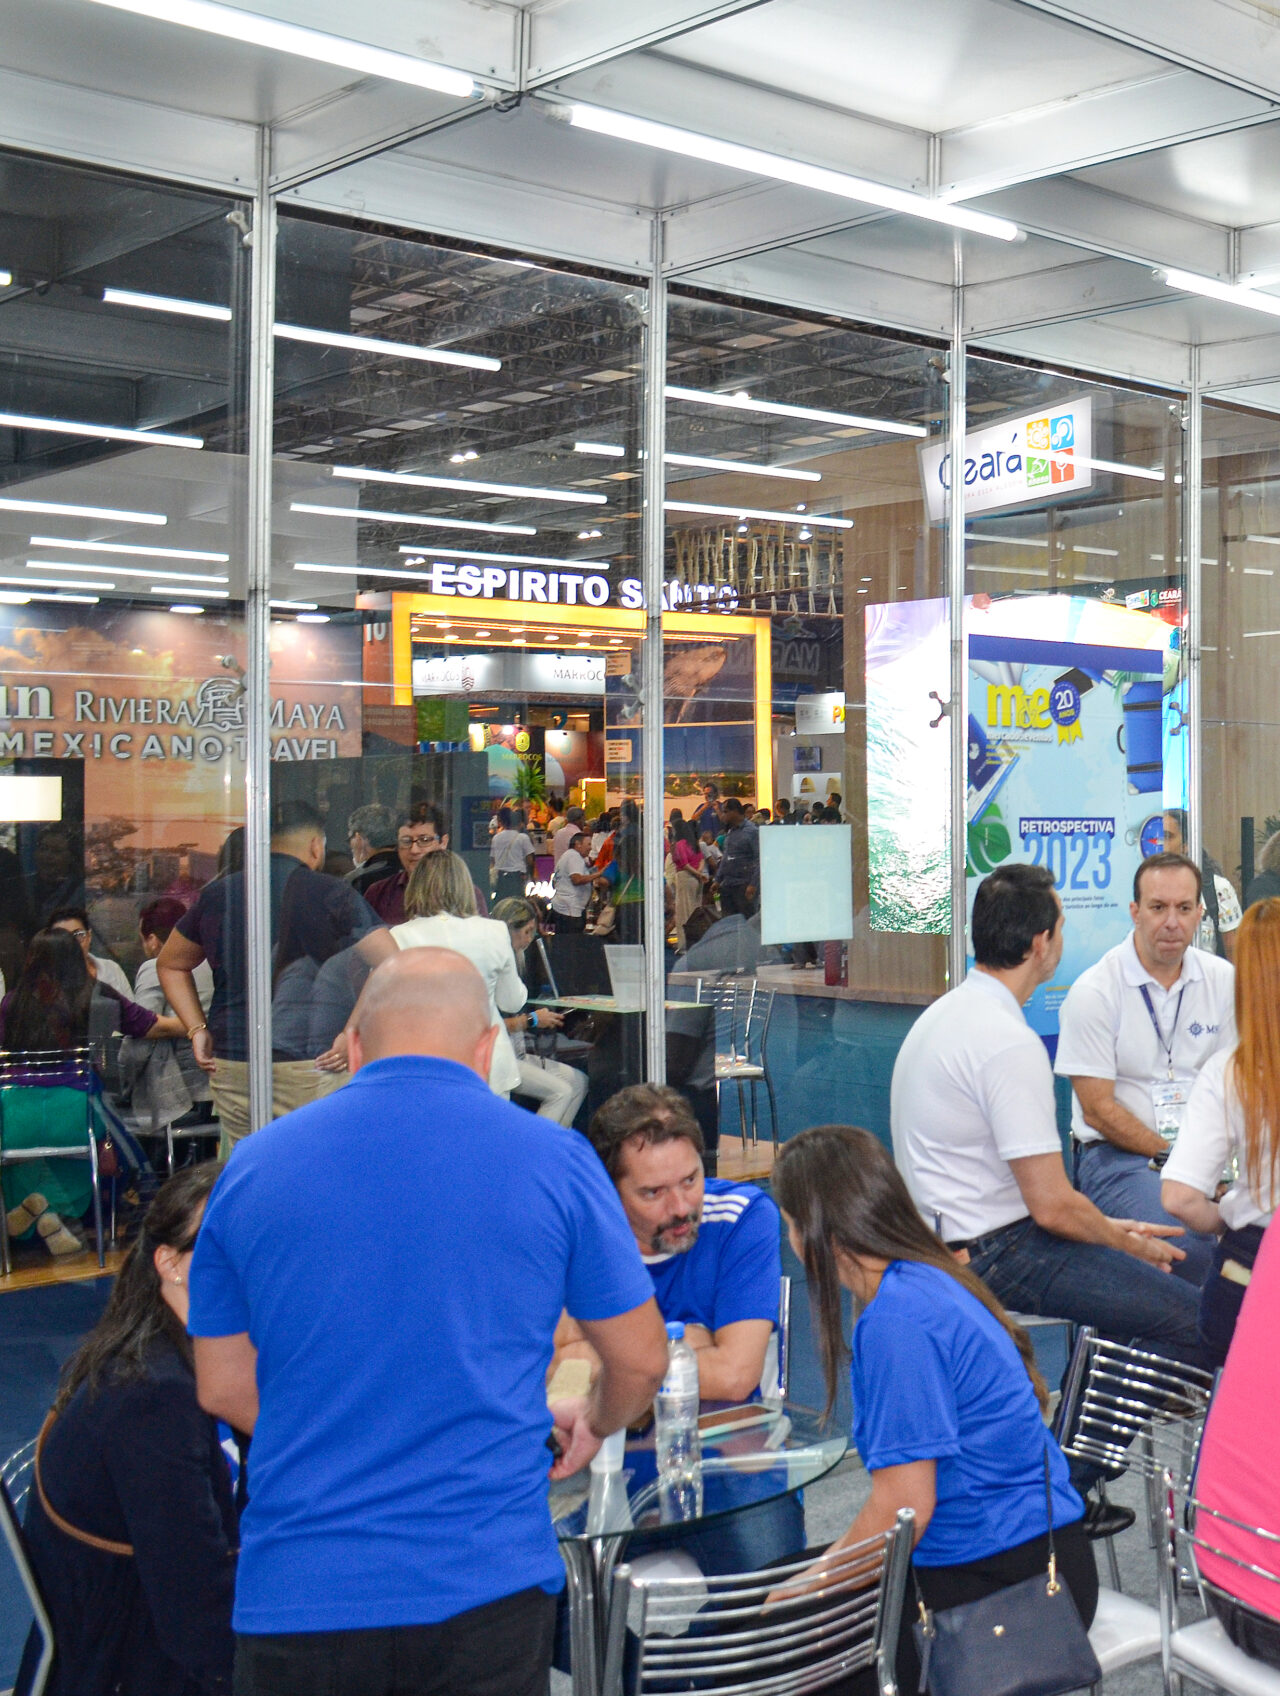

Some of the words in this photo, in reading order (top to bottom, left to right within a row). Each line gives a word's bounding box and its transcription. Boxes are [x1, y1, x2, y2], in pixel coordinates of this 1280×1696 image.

[431, 562, 610, 607] ESPIRITO
[553, 668, 606, 681] MARROC
[75, 690, 195, 726] RIVIERA
[1055, 689, 1074, 711] 20
[1020, 820, 1114, 834] RETROSPECTIVA
[1023, 831, 1112, 892] 2023
